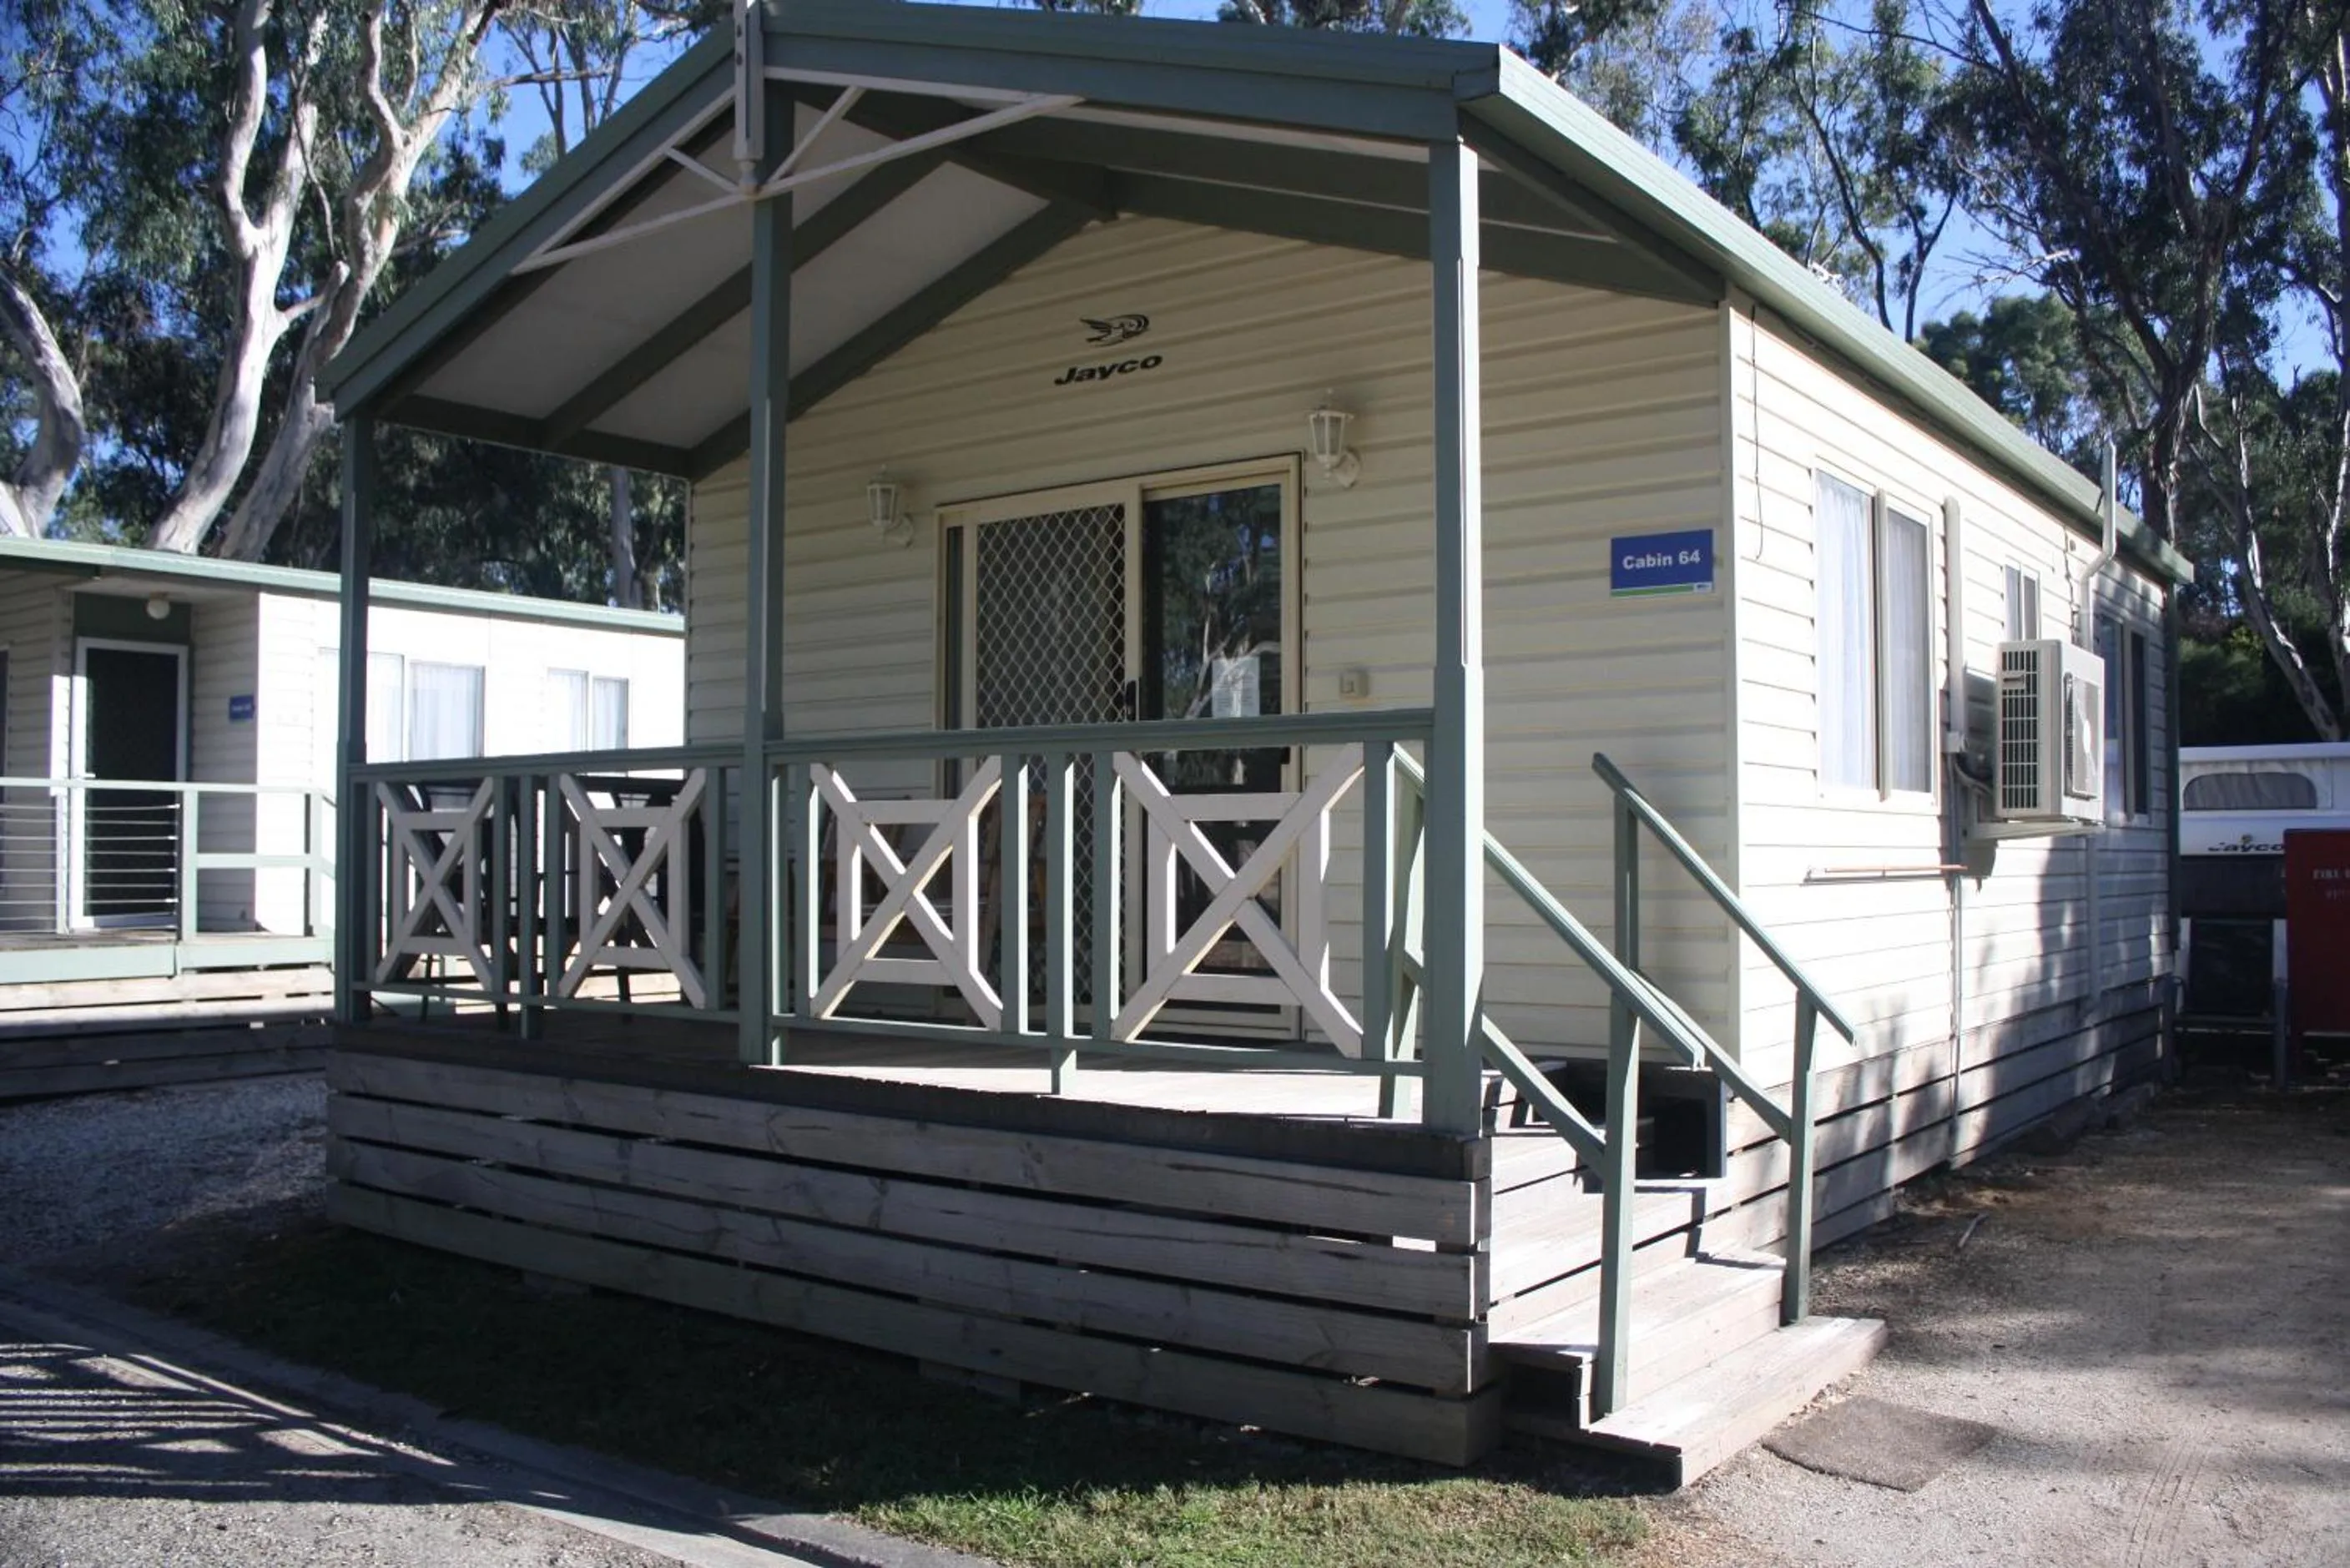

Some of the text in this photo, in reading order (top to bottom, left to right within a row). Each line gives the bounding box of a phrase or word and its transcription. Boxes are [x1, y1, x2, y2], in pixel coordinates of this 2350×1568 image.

[1054, 355, 1163, 386] Jayco
[1622, 549, 1701, 570] Cabin 64
